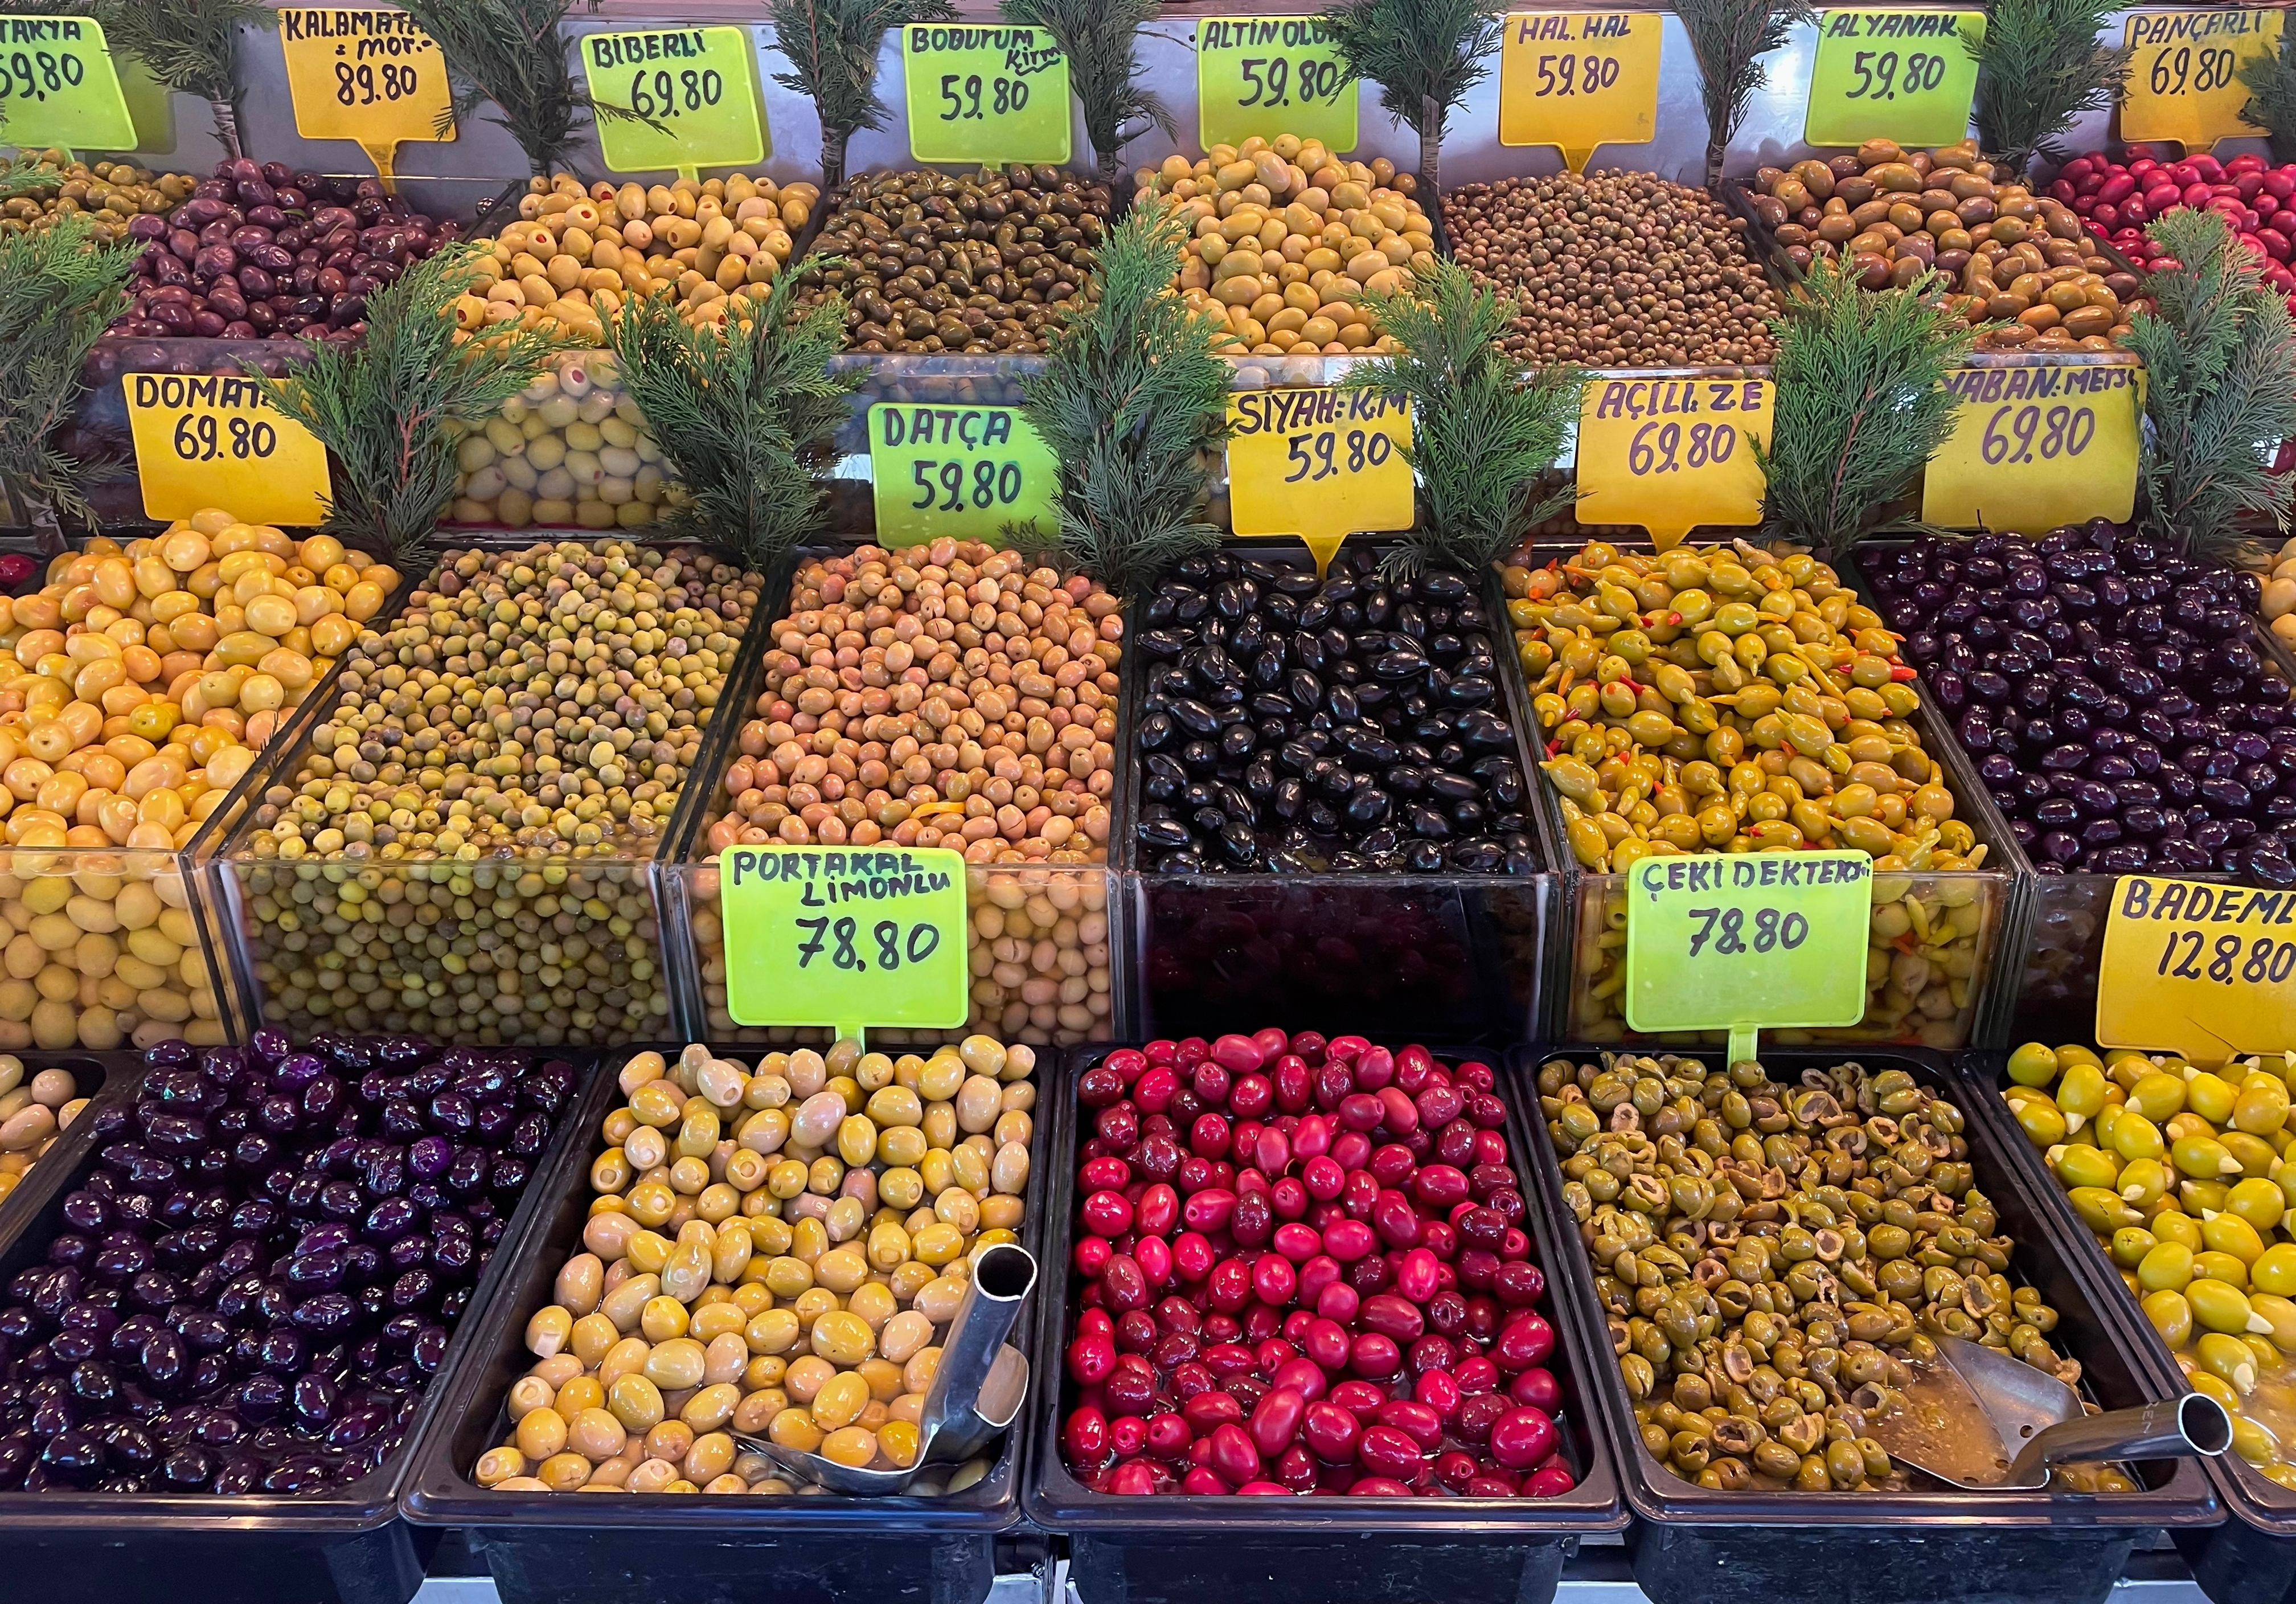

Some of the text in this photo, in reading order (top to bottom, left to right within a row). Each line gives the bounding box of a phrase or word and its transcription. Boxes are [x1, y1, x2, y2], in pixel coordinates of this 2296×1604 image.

[1827, 13, 1957, 38] ALYANAK
[335, 62, 417, 106] 89.80
[631, 69, 722, 118] 69.80
[1238, 57, 1337, 107] 59.80
[1536, 54, 1620, 97] 59.80
[1846, 51, 1945, 100] 59.80
[2151, 47, 2235, 95] 69.80
[940, 75, 1029, 120] 59.80
[174, 414, 276, 461] 69.80
[883, 408, 1012, 451] DATÇA
[1629, 421, 1736, 476] 69.80
[1982, 405, 2095, 465] 69.80
[1285, 429, 1391, 482] 59.80
[912, 460, 1022, 512] 59.80
[734, 852, 924, 885] PORTAKAL
[2122, 879, 2296, 924] BADEML
[1688, 907, 1809, 957] 78.80
[2158, 931, 2296, 985] 128.80
